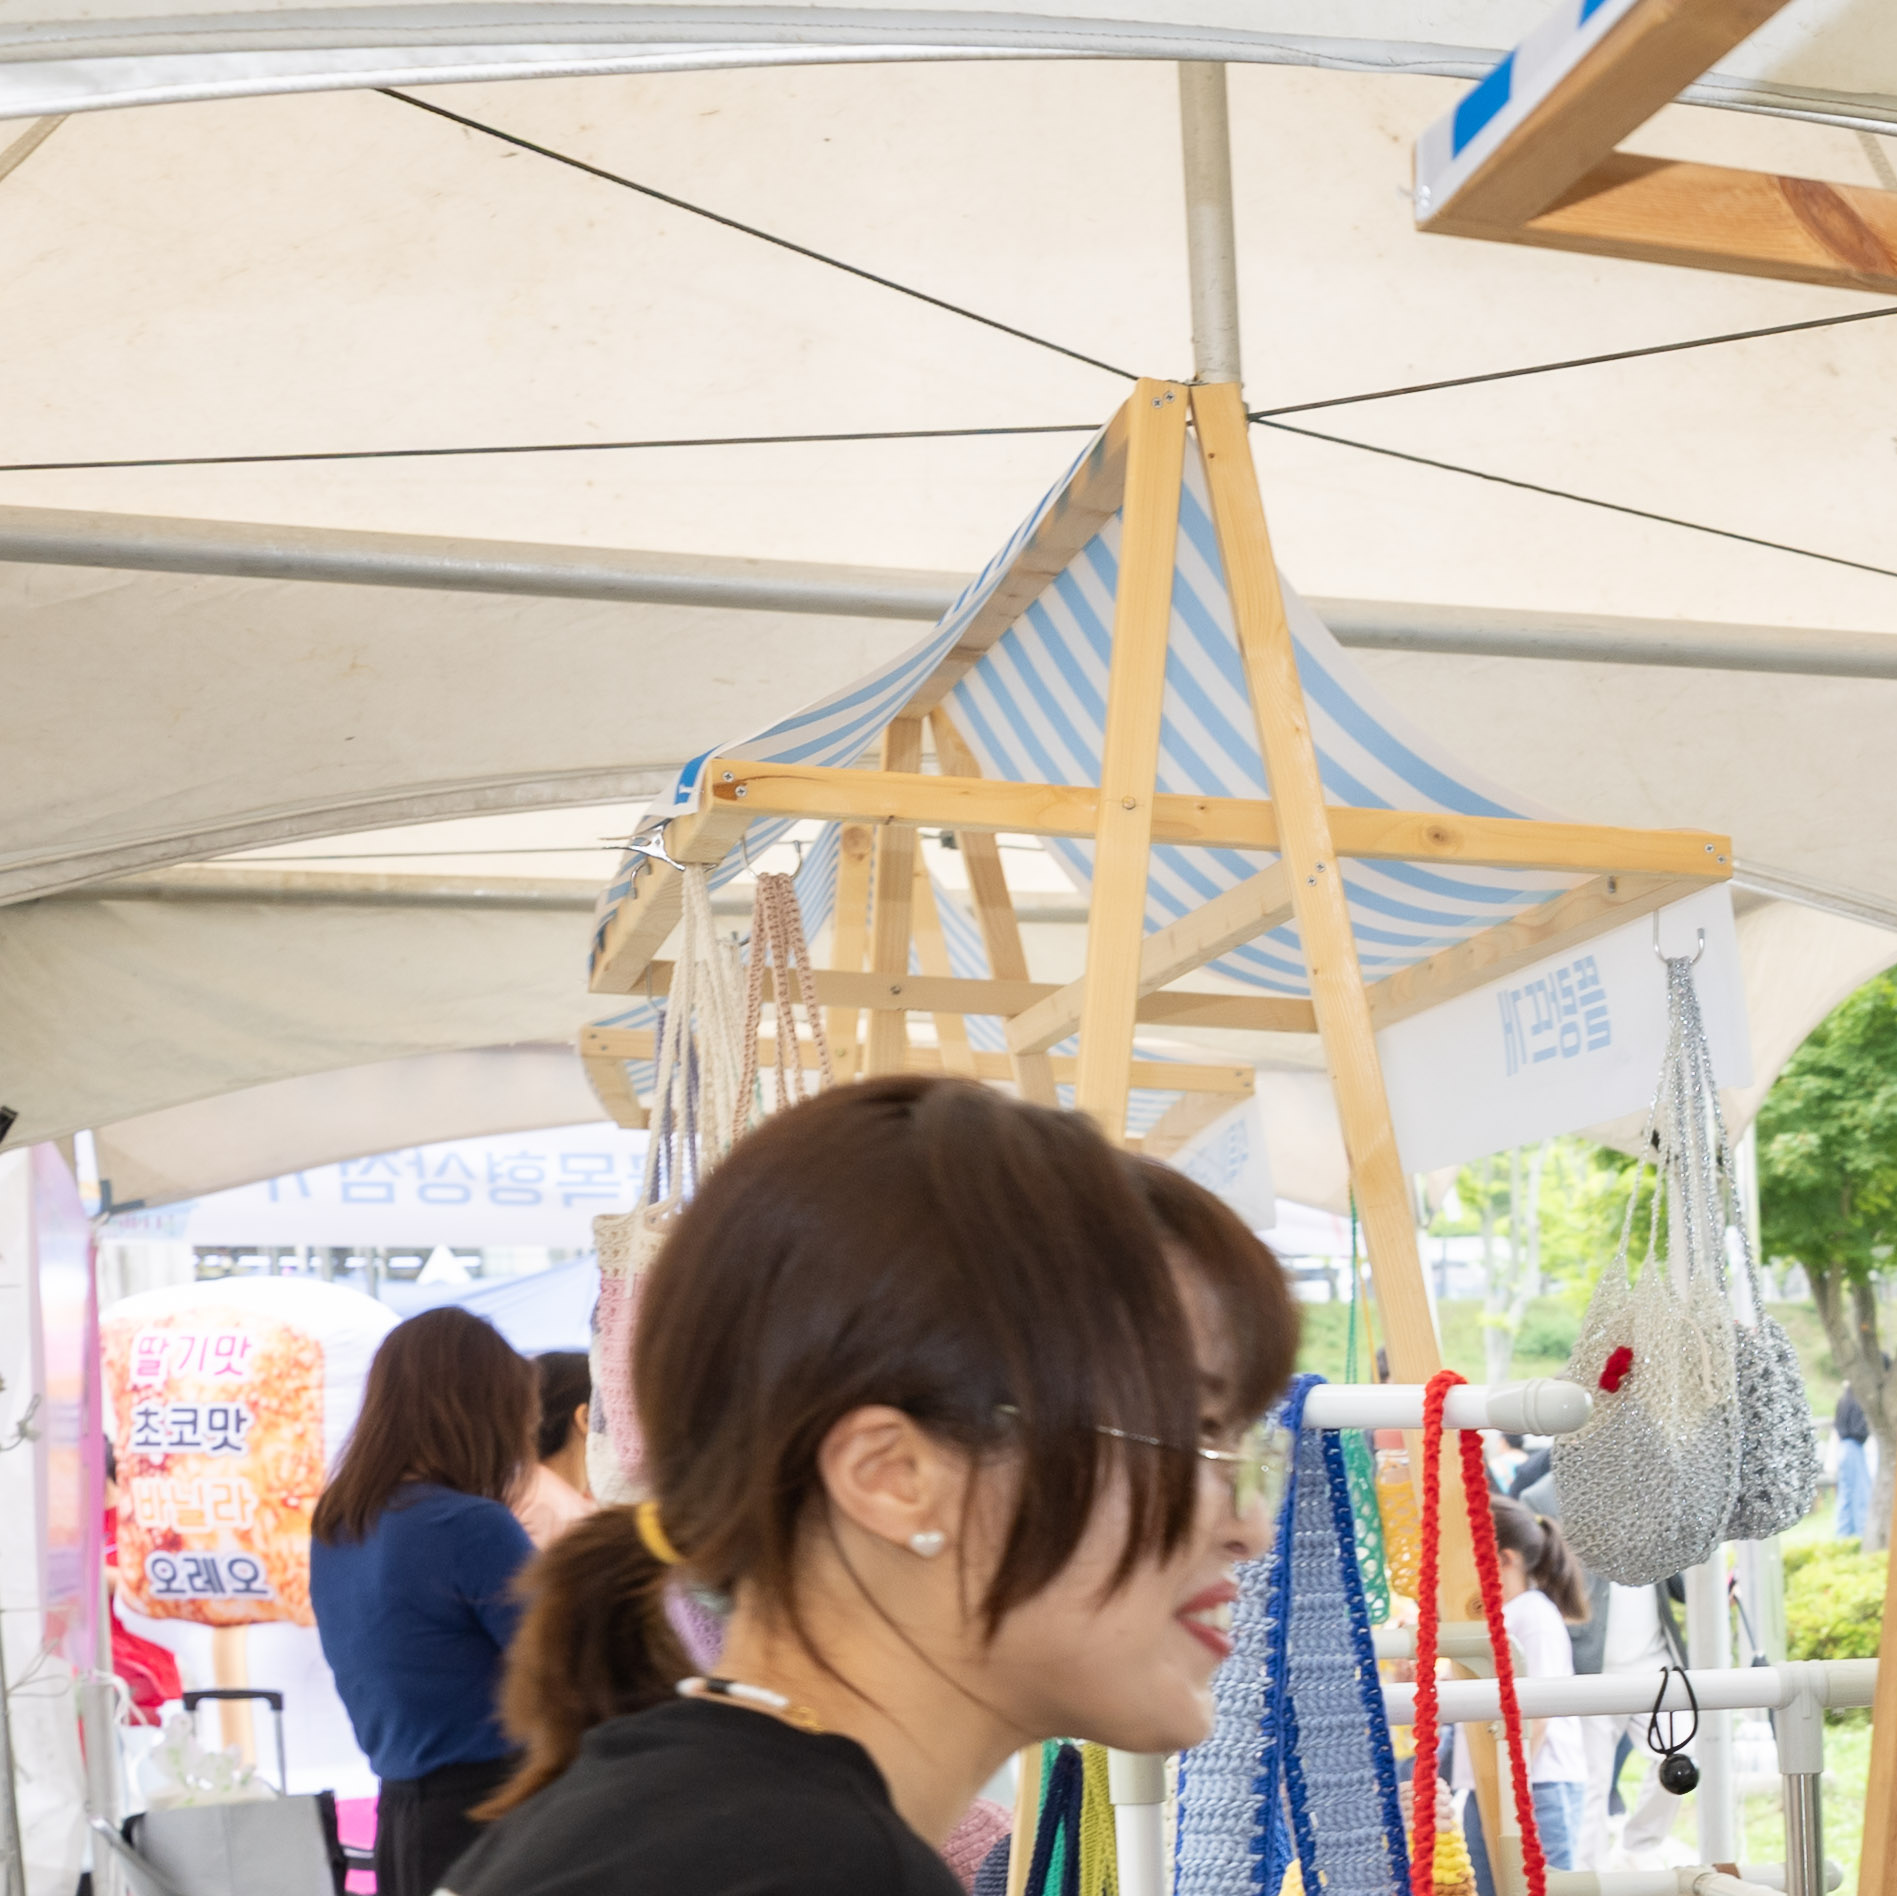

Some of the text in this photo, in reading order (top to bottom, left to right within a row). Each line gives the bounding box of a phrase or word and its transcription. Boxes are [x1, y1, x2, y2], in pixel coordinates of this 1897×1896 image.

[136, 1335, 252, 1377] 딸기맛
[134, 1406, 248, 1452] 초코맛
[138, 1484, 251, 1528] 바닐라
[150, 1557, 269, 1595] 오레오
